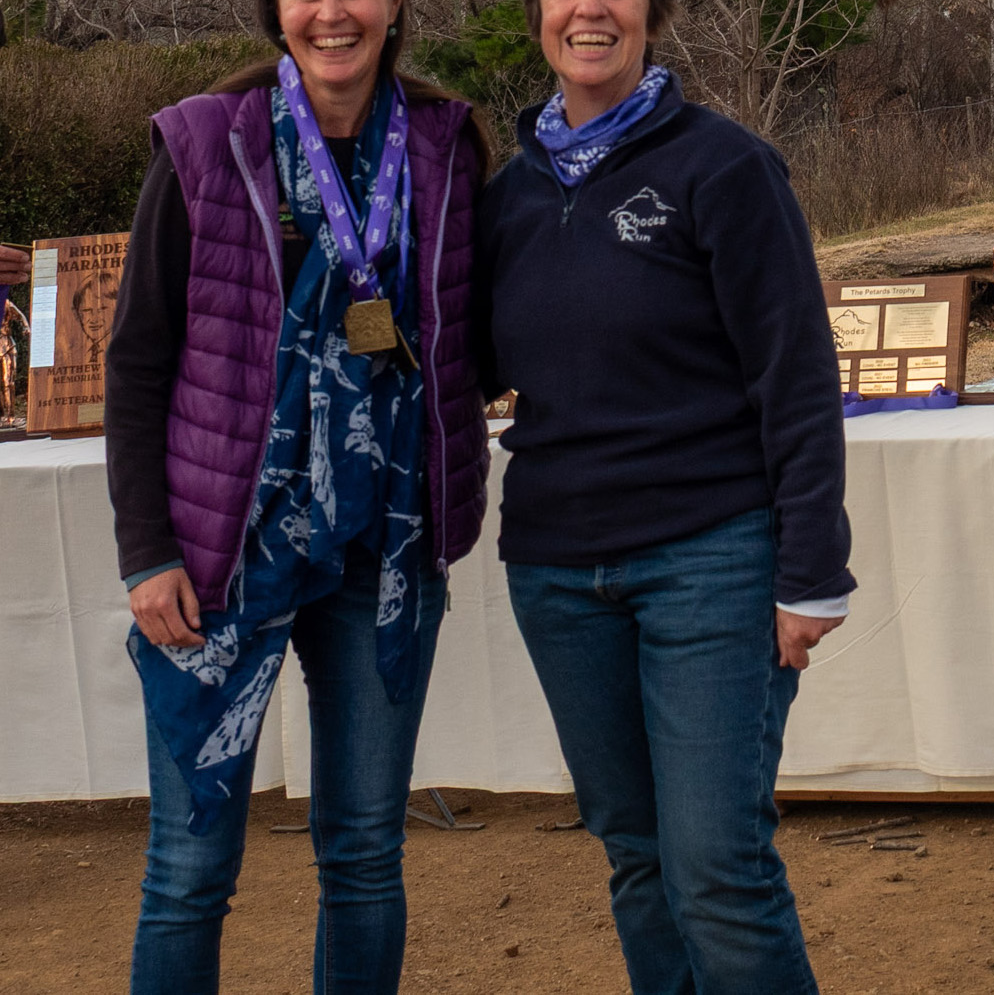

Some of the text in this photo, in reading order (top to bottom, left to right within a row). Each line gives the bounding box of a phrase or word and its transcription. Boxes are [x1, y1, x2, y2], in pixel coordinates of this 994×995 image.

[614, 210, 668, 230] Rhodes
[618, 225, 652, 242] Run
[865, 288, 891, 296] Petards
[892, 287, 916, 295] Trophy
[831, 325, 865, 338] Rhodes
[833, 336, 853, 348] Run
[47, 364, 101, 376] MATTHEW
[53, 374, 102, 384] MEMORIAL
[38, 394, 104, 408] 1st VETERAN
